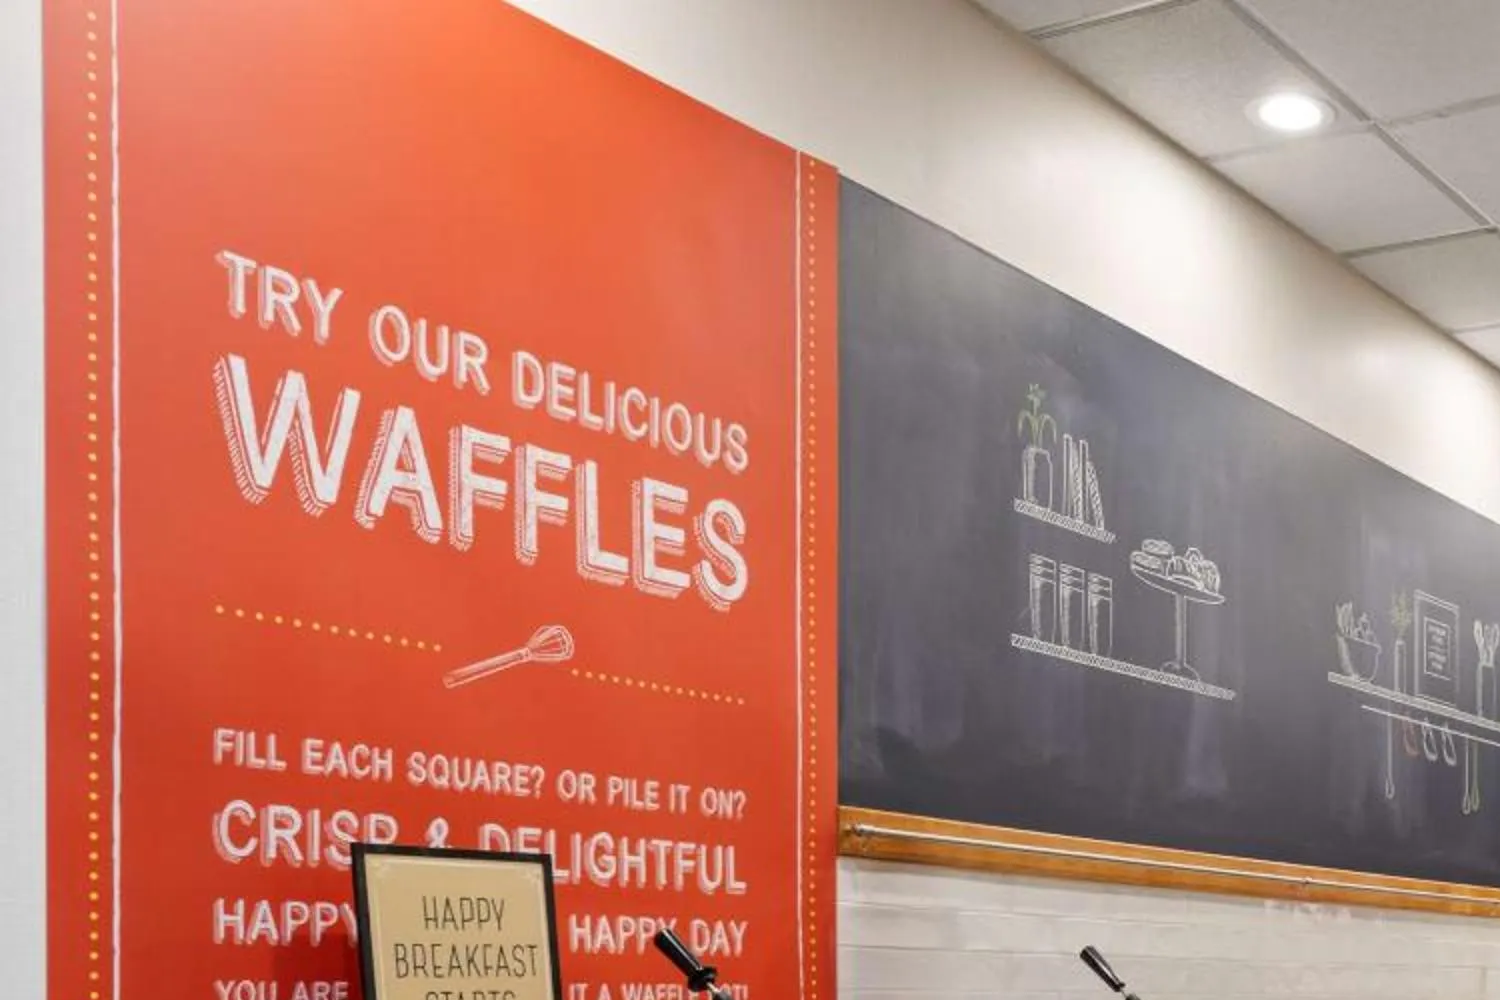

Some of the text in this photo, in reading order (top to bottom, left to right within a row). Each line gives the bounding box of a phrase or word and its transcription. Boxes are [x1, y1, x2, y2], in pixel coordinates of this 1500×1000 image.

[215, 250, 750, 476] TRY OUR DELICIOUS
[211, 352, 749, 613] WAFFLES
[213, 728, 748, 820] FILL EACH SQUARE? OR PILE IT ON?
[422, 895, 505, 931] HAPPY
[688, 918, 750, 957] DAY
[394, 943, 538, 979] BREAKFAST
